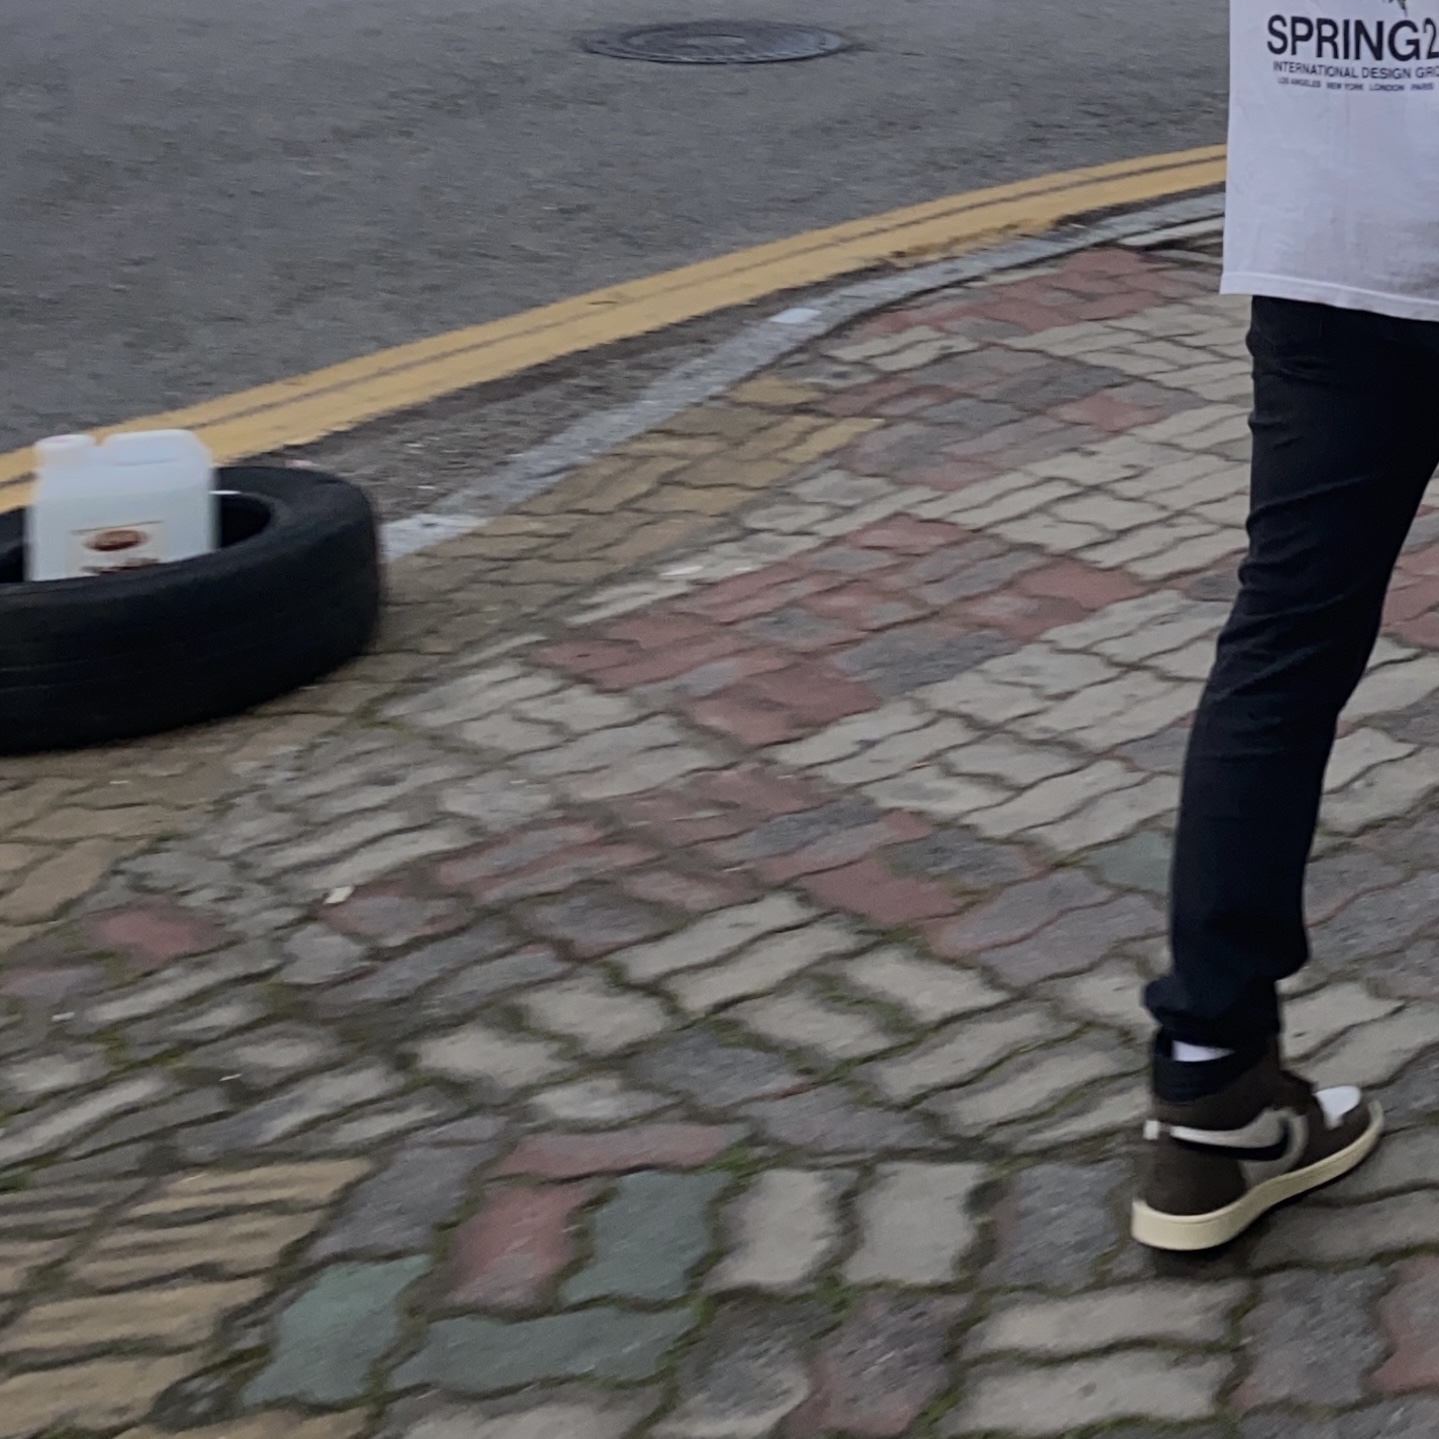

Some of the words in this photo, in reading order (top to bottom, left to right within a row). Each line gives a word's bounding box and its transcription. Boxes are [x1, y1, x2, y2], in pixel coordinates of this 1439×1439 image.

[1273, 60, 1359, 79] INTERNATIONAL
[1361, 66, 1412, 80] DESIGN
[1369, 83, 1405, 92] LONDON
